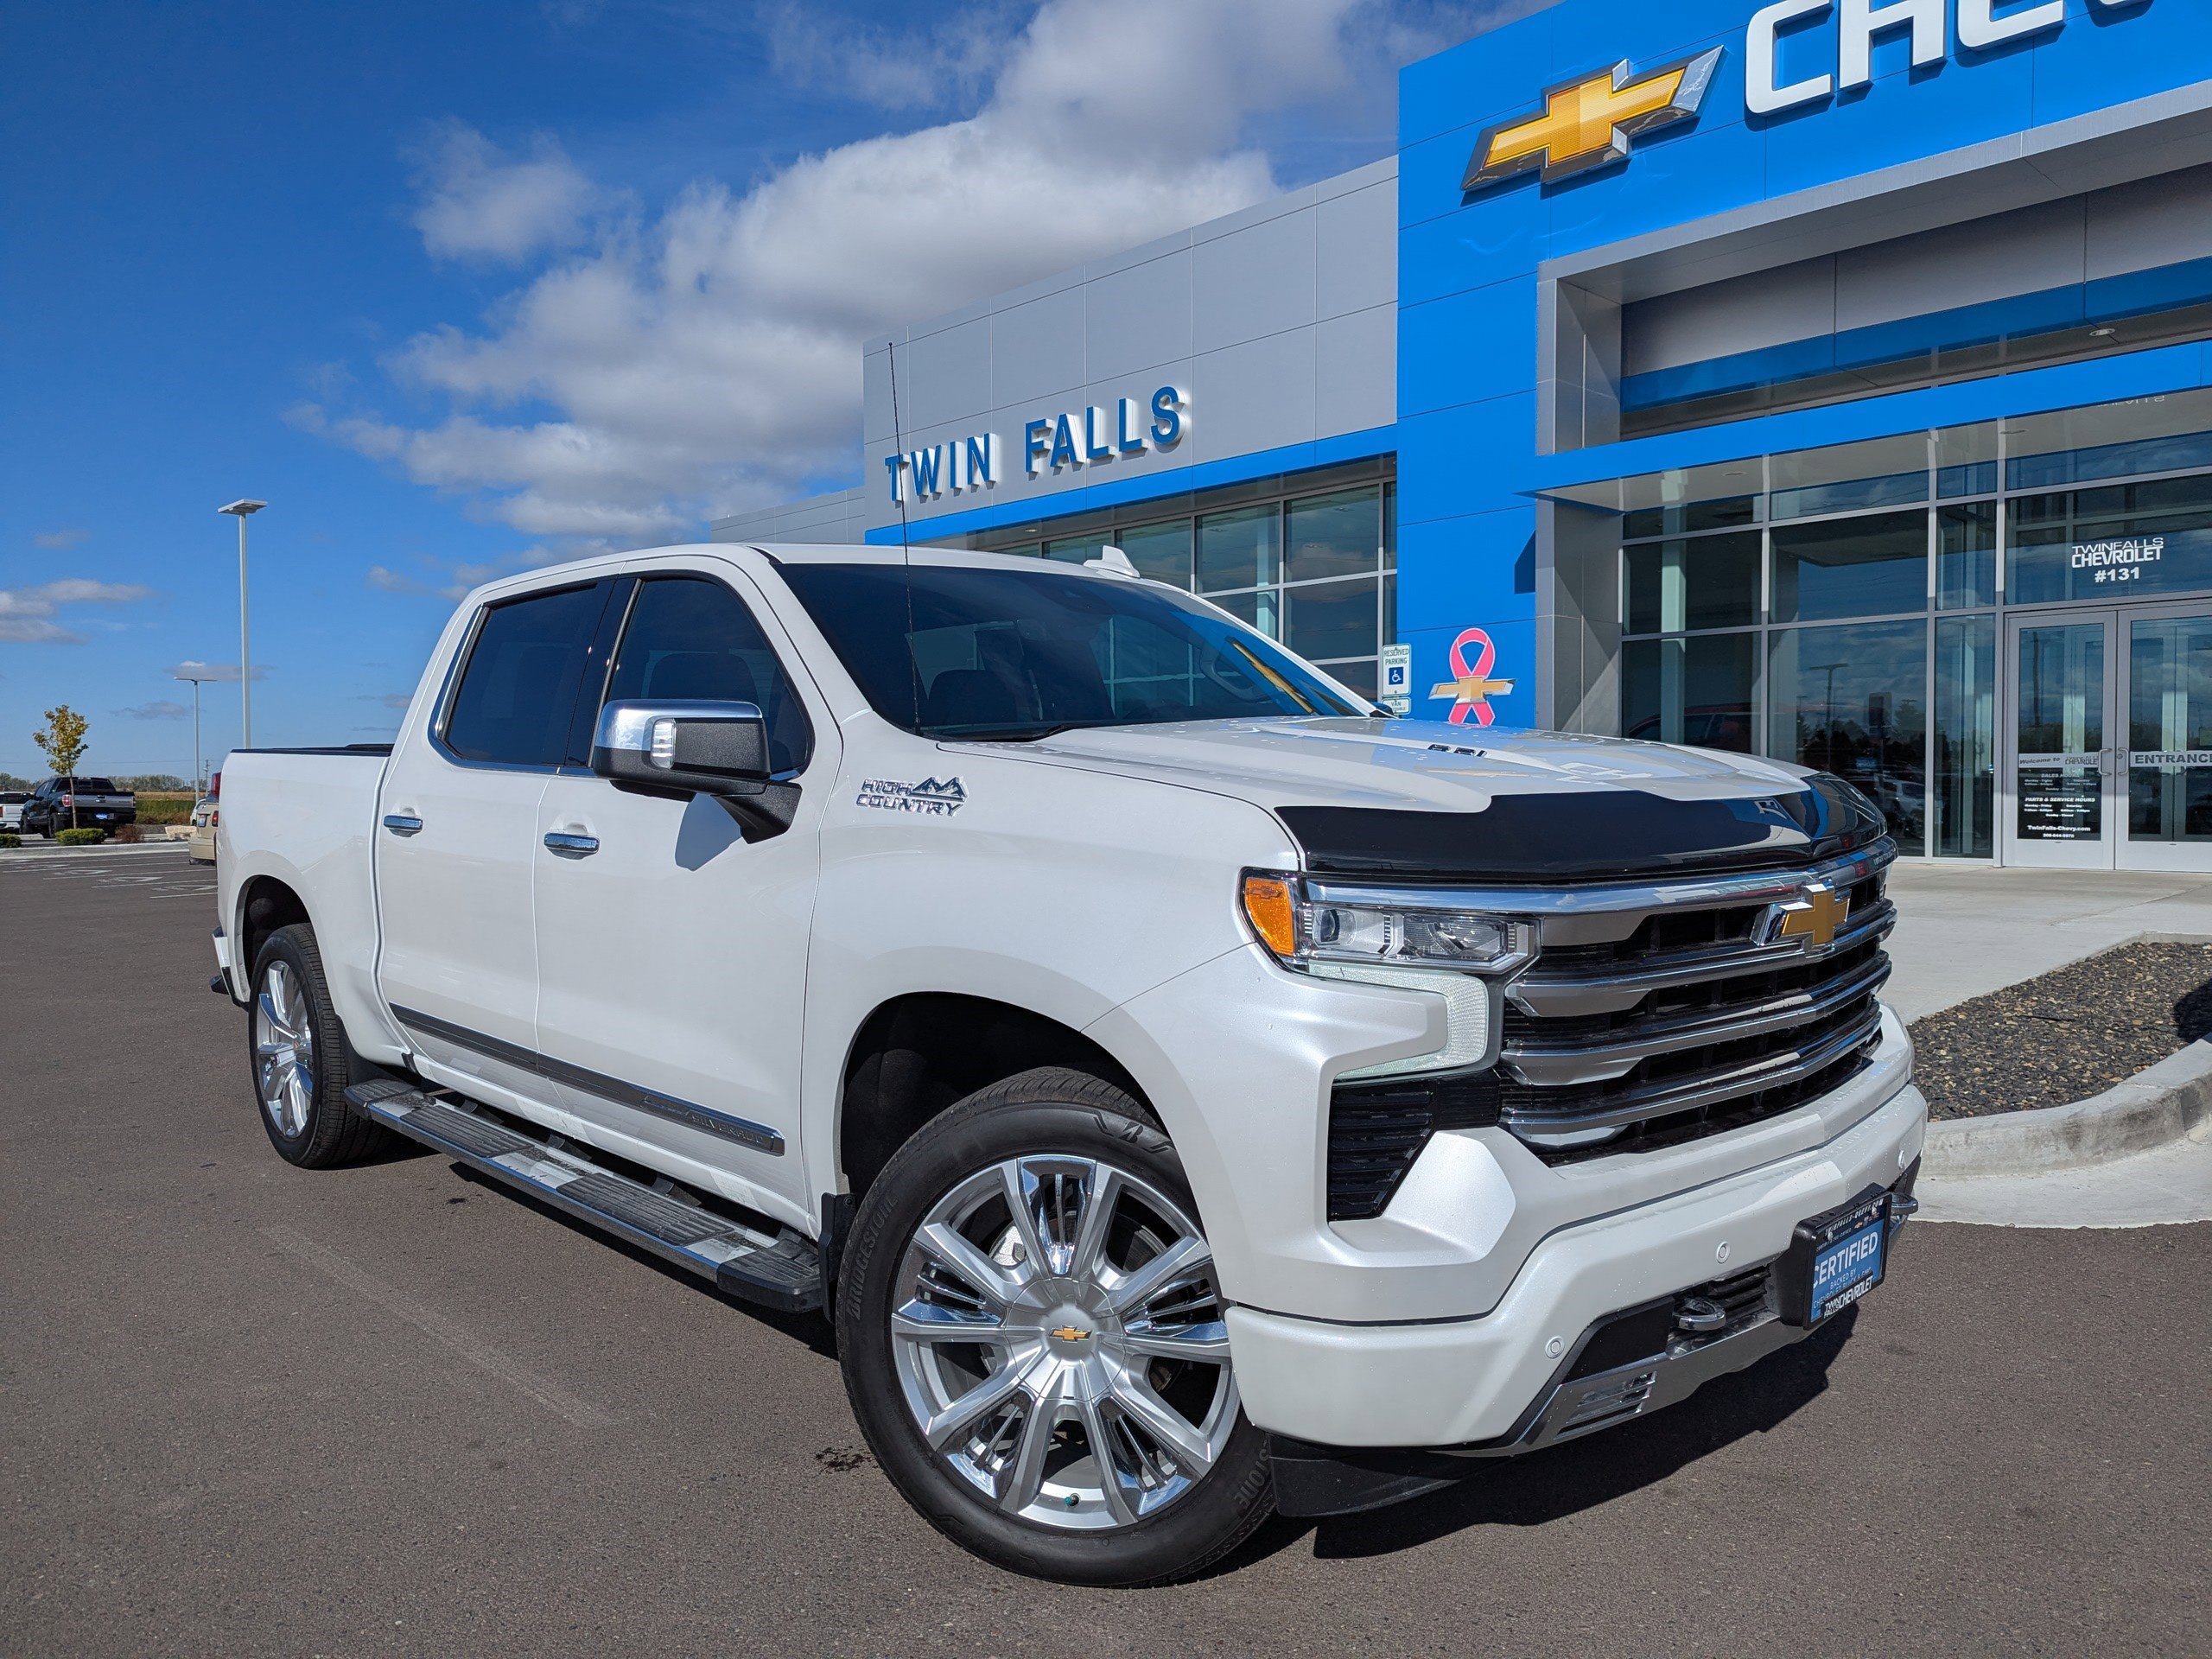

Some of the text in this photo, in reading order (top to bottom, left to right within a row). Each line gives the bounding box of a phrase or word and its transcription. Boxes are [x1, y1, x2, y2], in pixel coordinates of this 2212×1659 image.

[1745, 0, 2157, 114] CHE
[885, 386, 1187, 502] TWIN FALLS
[2071, 537, 2164, 554] TWINFALLS
[2071, 546, 2164, 569] CHEVROLET
[2094, 567, 2140, 583] #131
[1383, 648, 1410, 658] RESERVED
[861, 779, 914, 796] HIGH
[856, 793, 964, 817] COUNTRY
[691, 1115, 763, 1143] SILVERADO
[1829, 1268, 1857, 1289] BACKED BY
[1838, 1274, 1874, 1309] CHEVROLET
